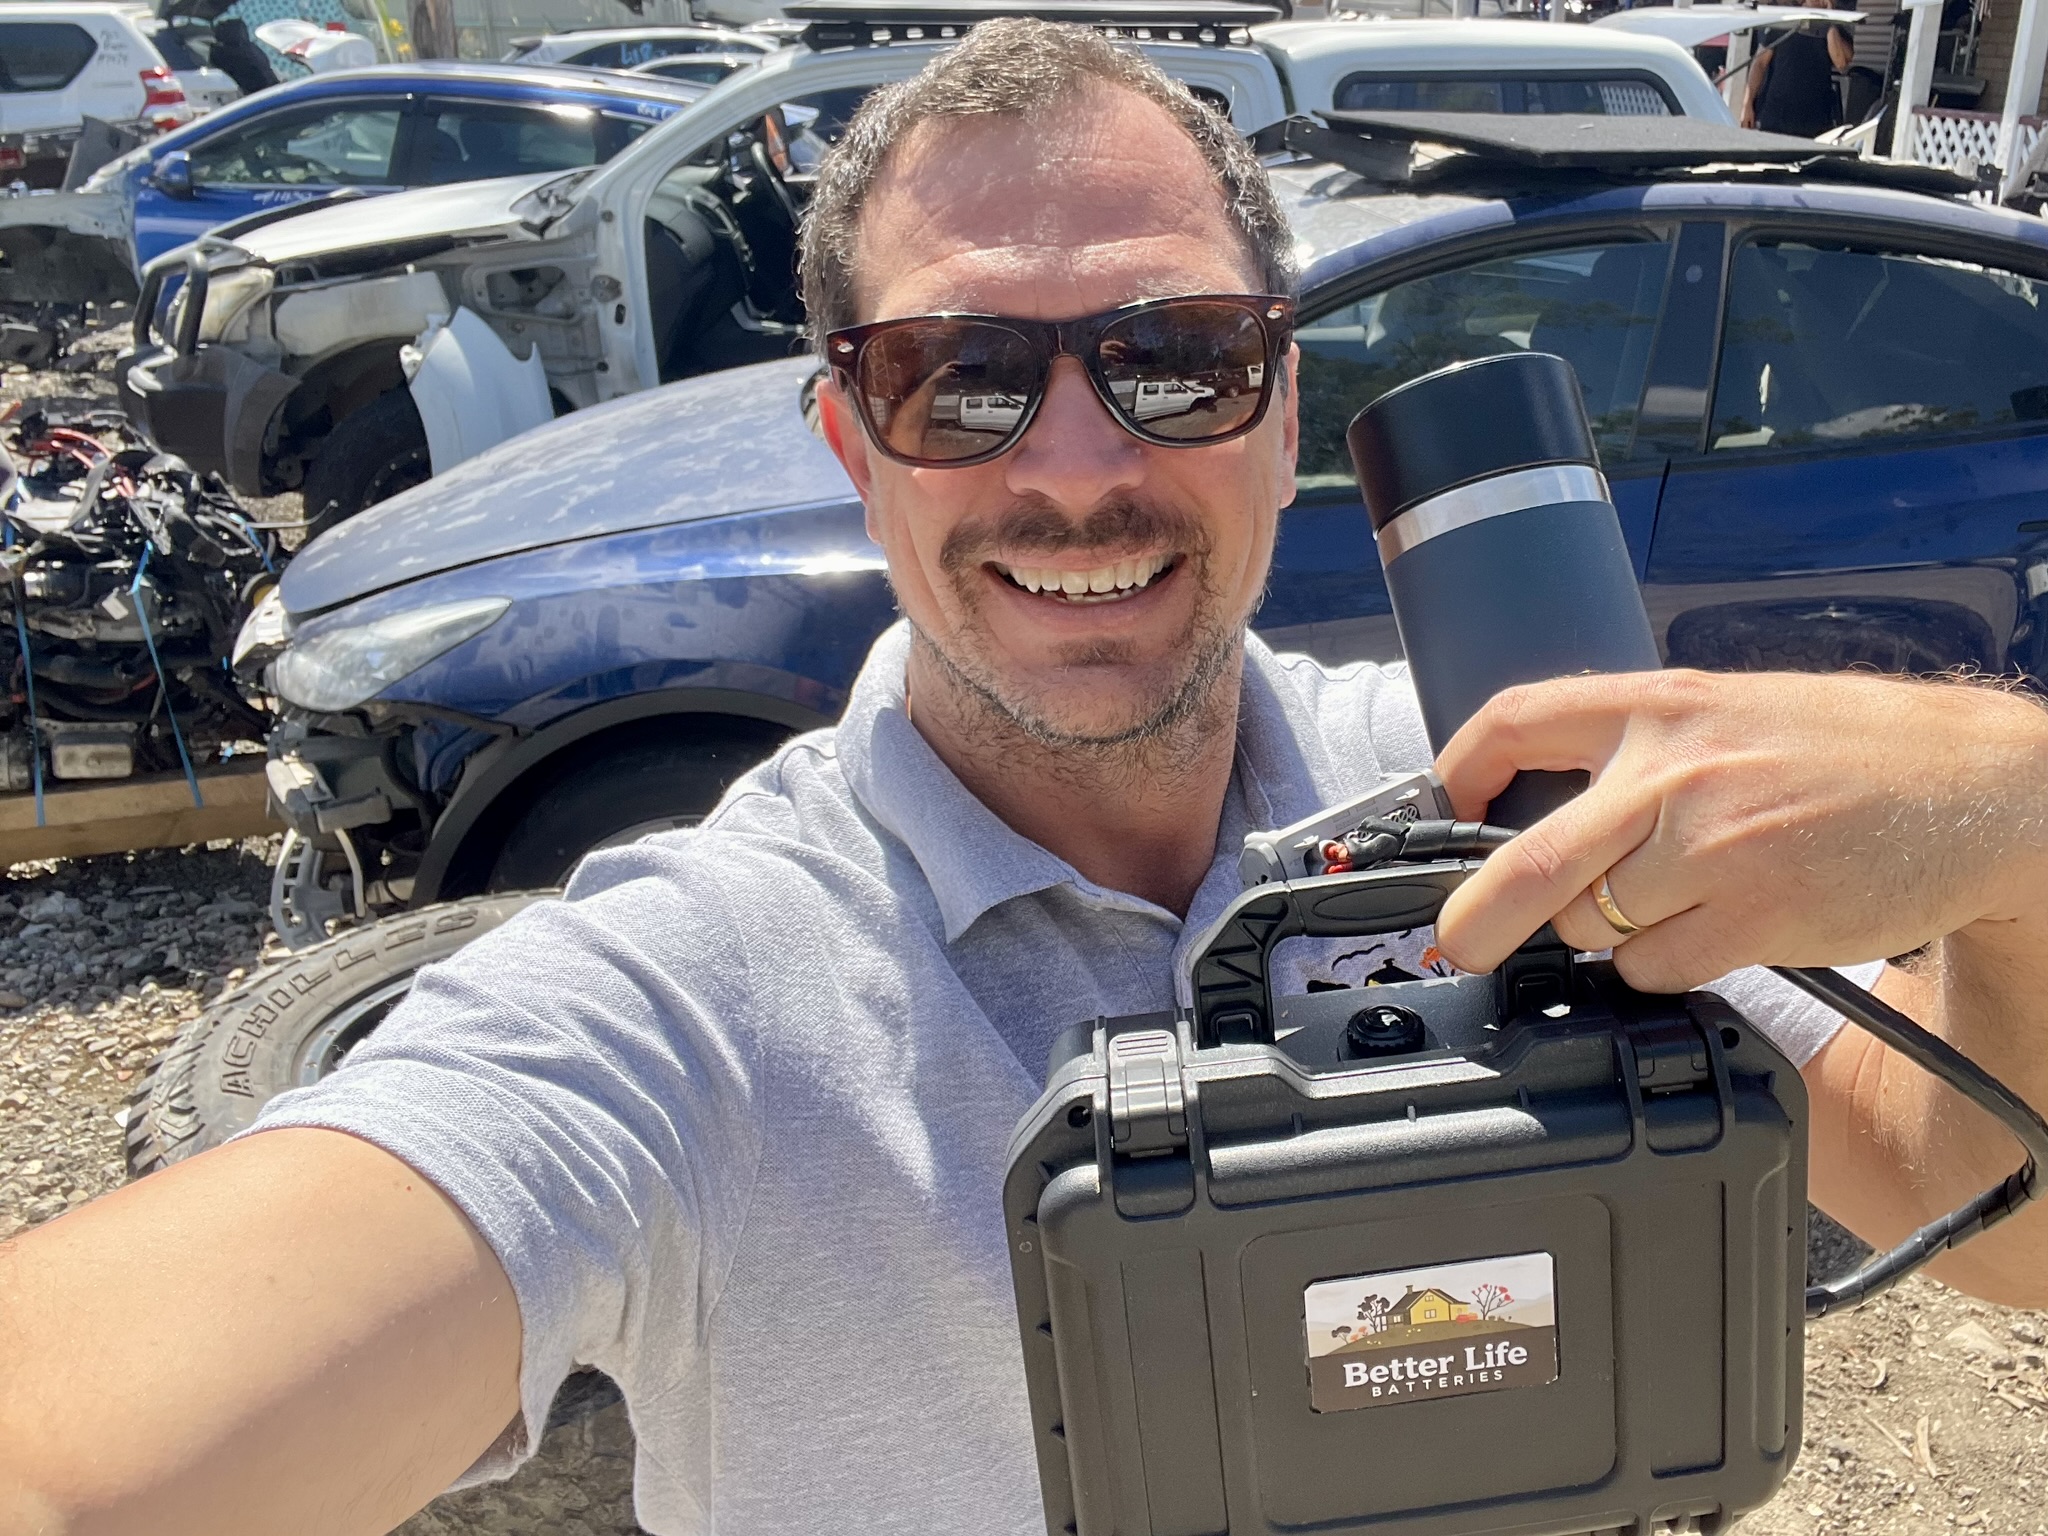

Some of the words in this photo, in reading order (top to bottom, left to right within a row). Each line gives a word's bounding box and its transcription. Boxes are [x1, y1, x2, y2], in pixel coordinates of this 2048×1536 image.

[220, 908, 478, 1098] ACHILLES
[1343, 1353, 1454, 1388] Better
[1464, 1341, 1528, 1372] Life
[1371, 1370, 1503, 1398] BATTERIES
